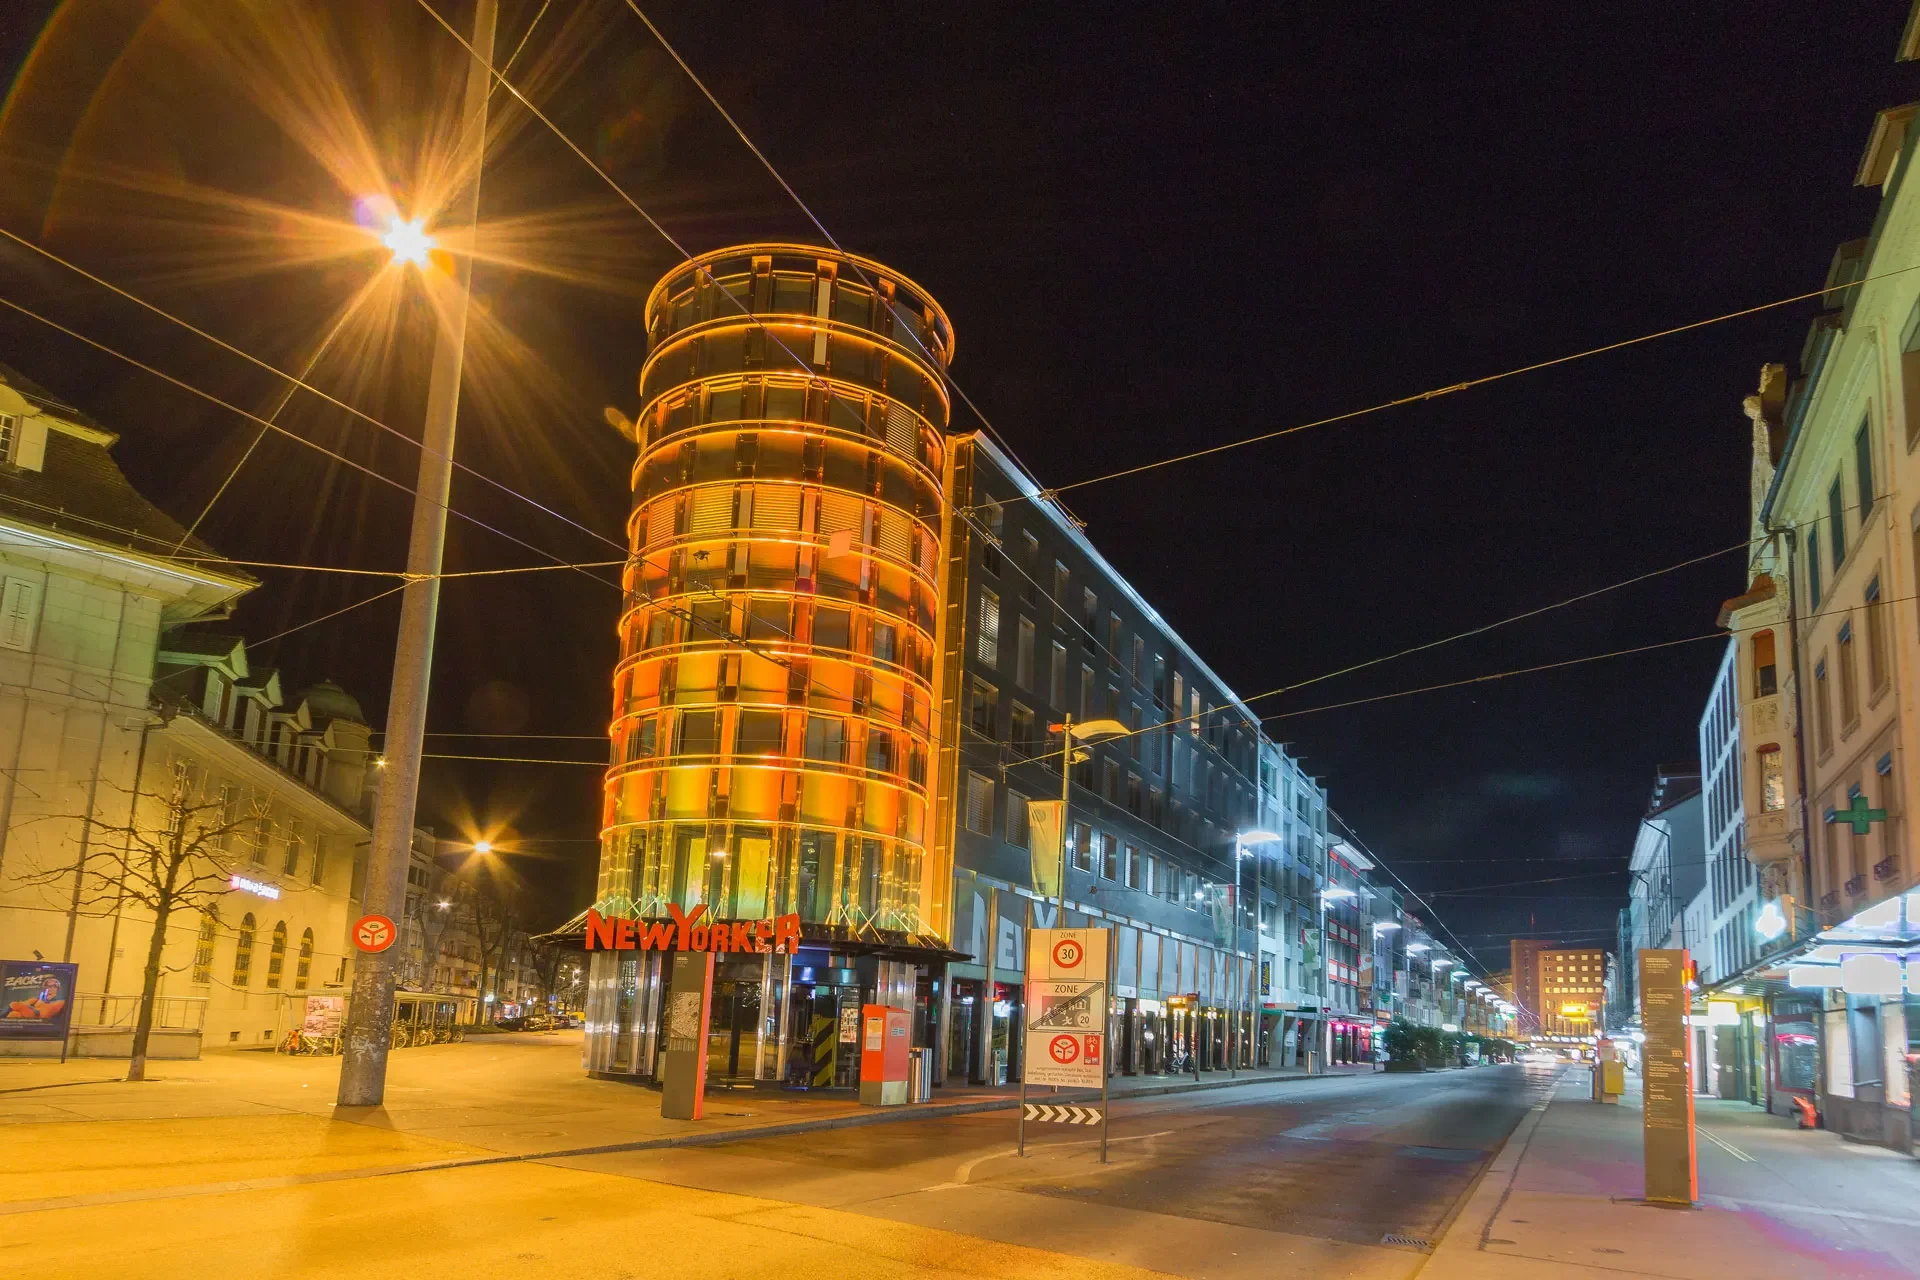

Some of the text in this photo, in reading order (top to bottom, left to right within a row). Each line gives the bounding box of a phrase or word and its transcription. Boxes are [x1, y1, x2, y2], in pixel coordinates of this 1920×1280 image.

[1060, 931, 1077, 939] ZONE
[1061, 948, 1074, 960] 30
[1054, 984, 1079, 994] ZONE
[1080, 1015, 1090, 1024] 20
